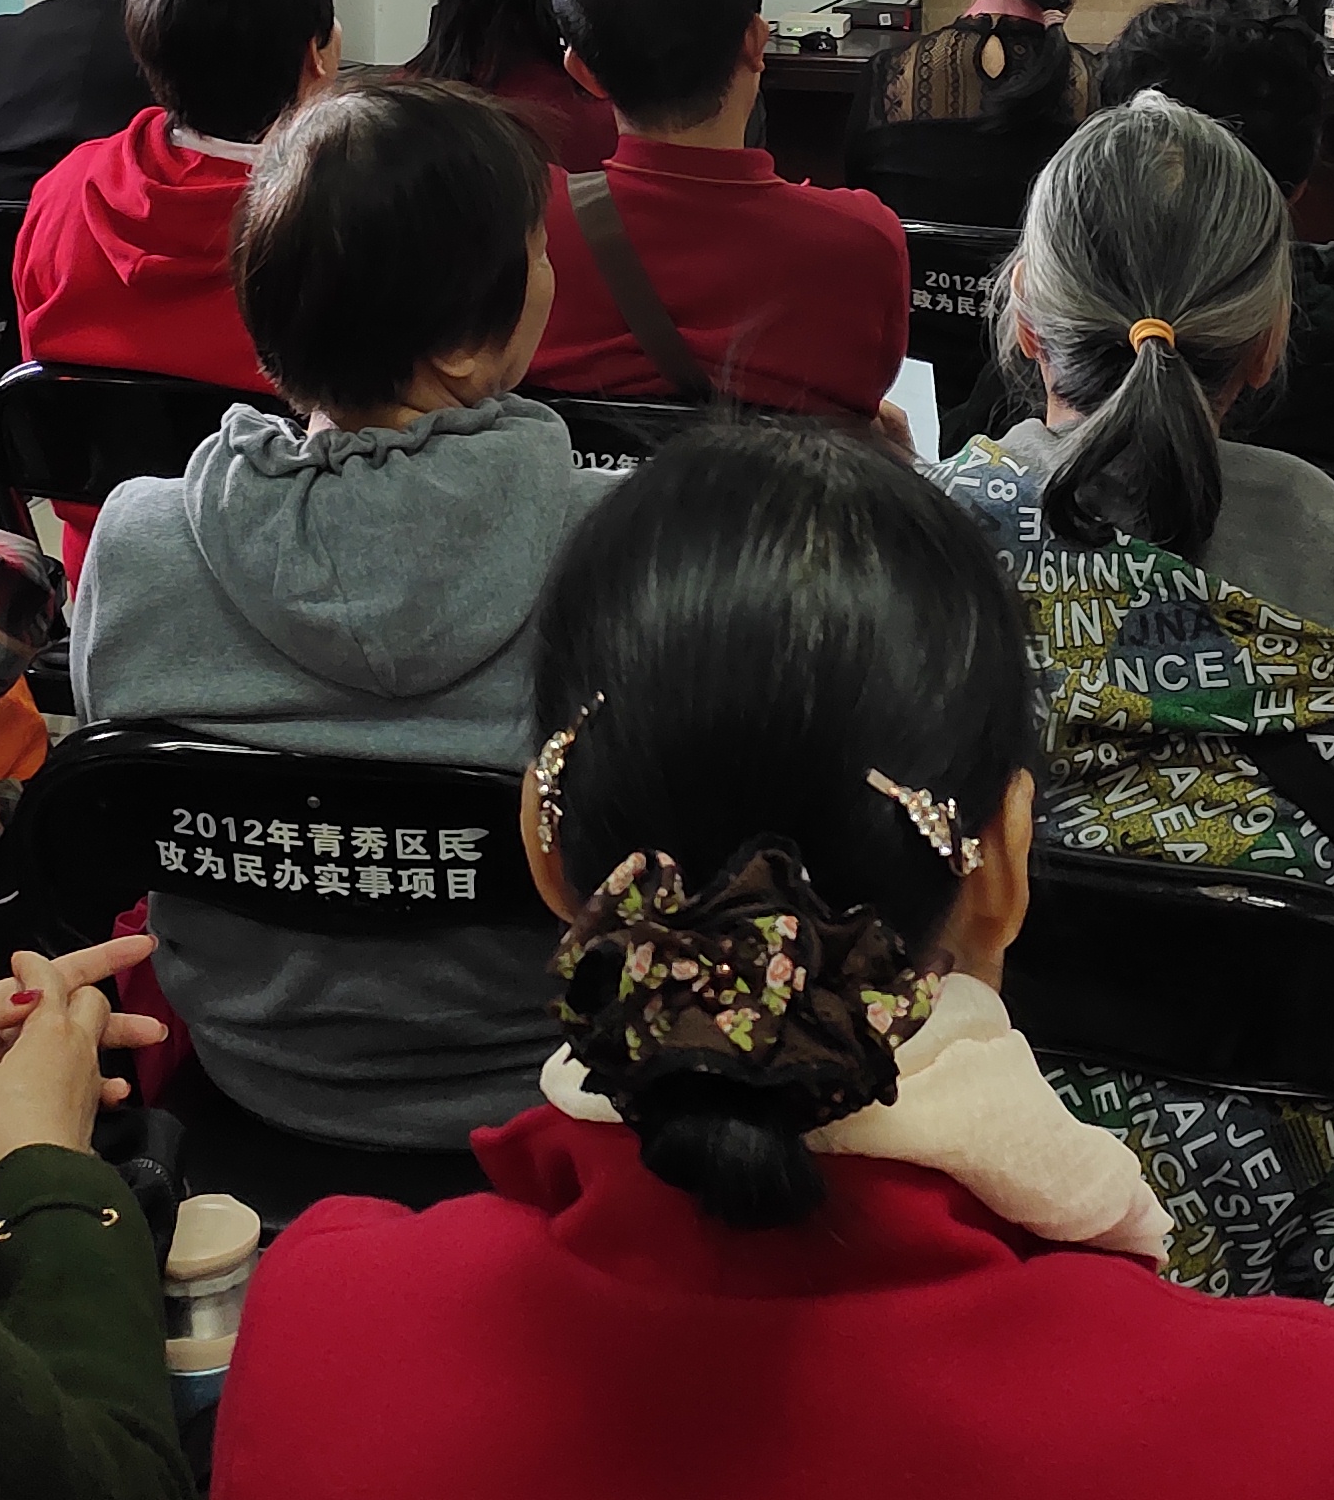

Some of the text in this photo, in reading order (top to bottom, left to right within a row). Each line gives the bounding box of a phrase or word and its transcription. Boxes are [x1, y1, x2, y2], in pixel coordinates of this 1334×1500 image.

[172, 808, 490, 862] 2012年青秀区民
